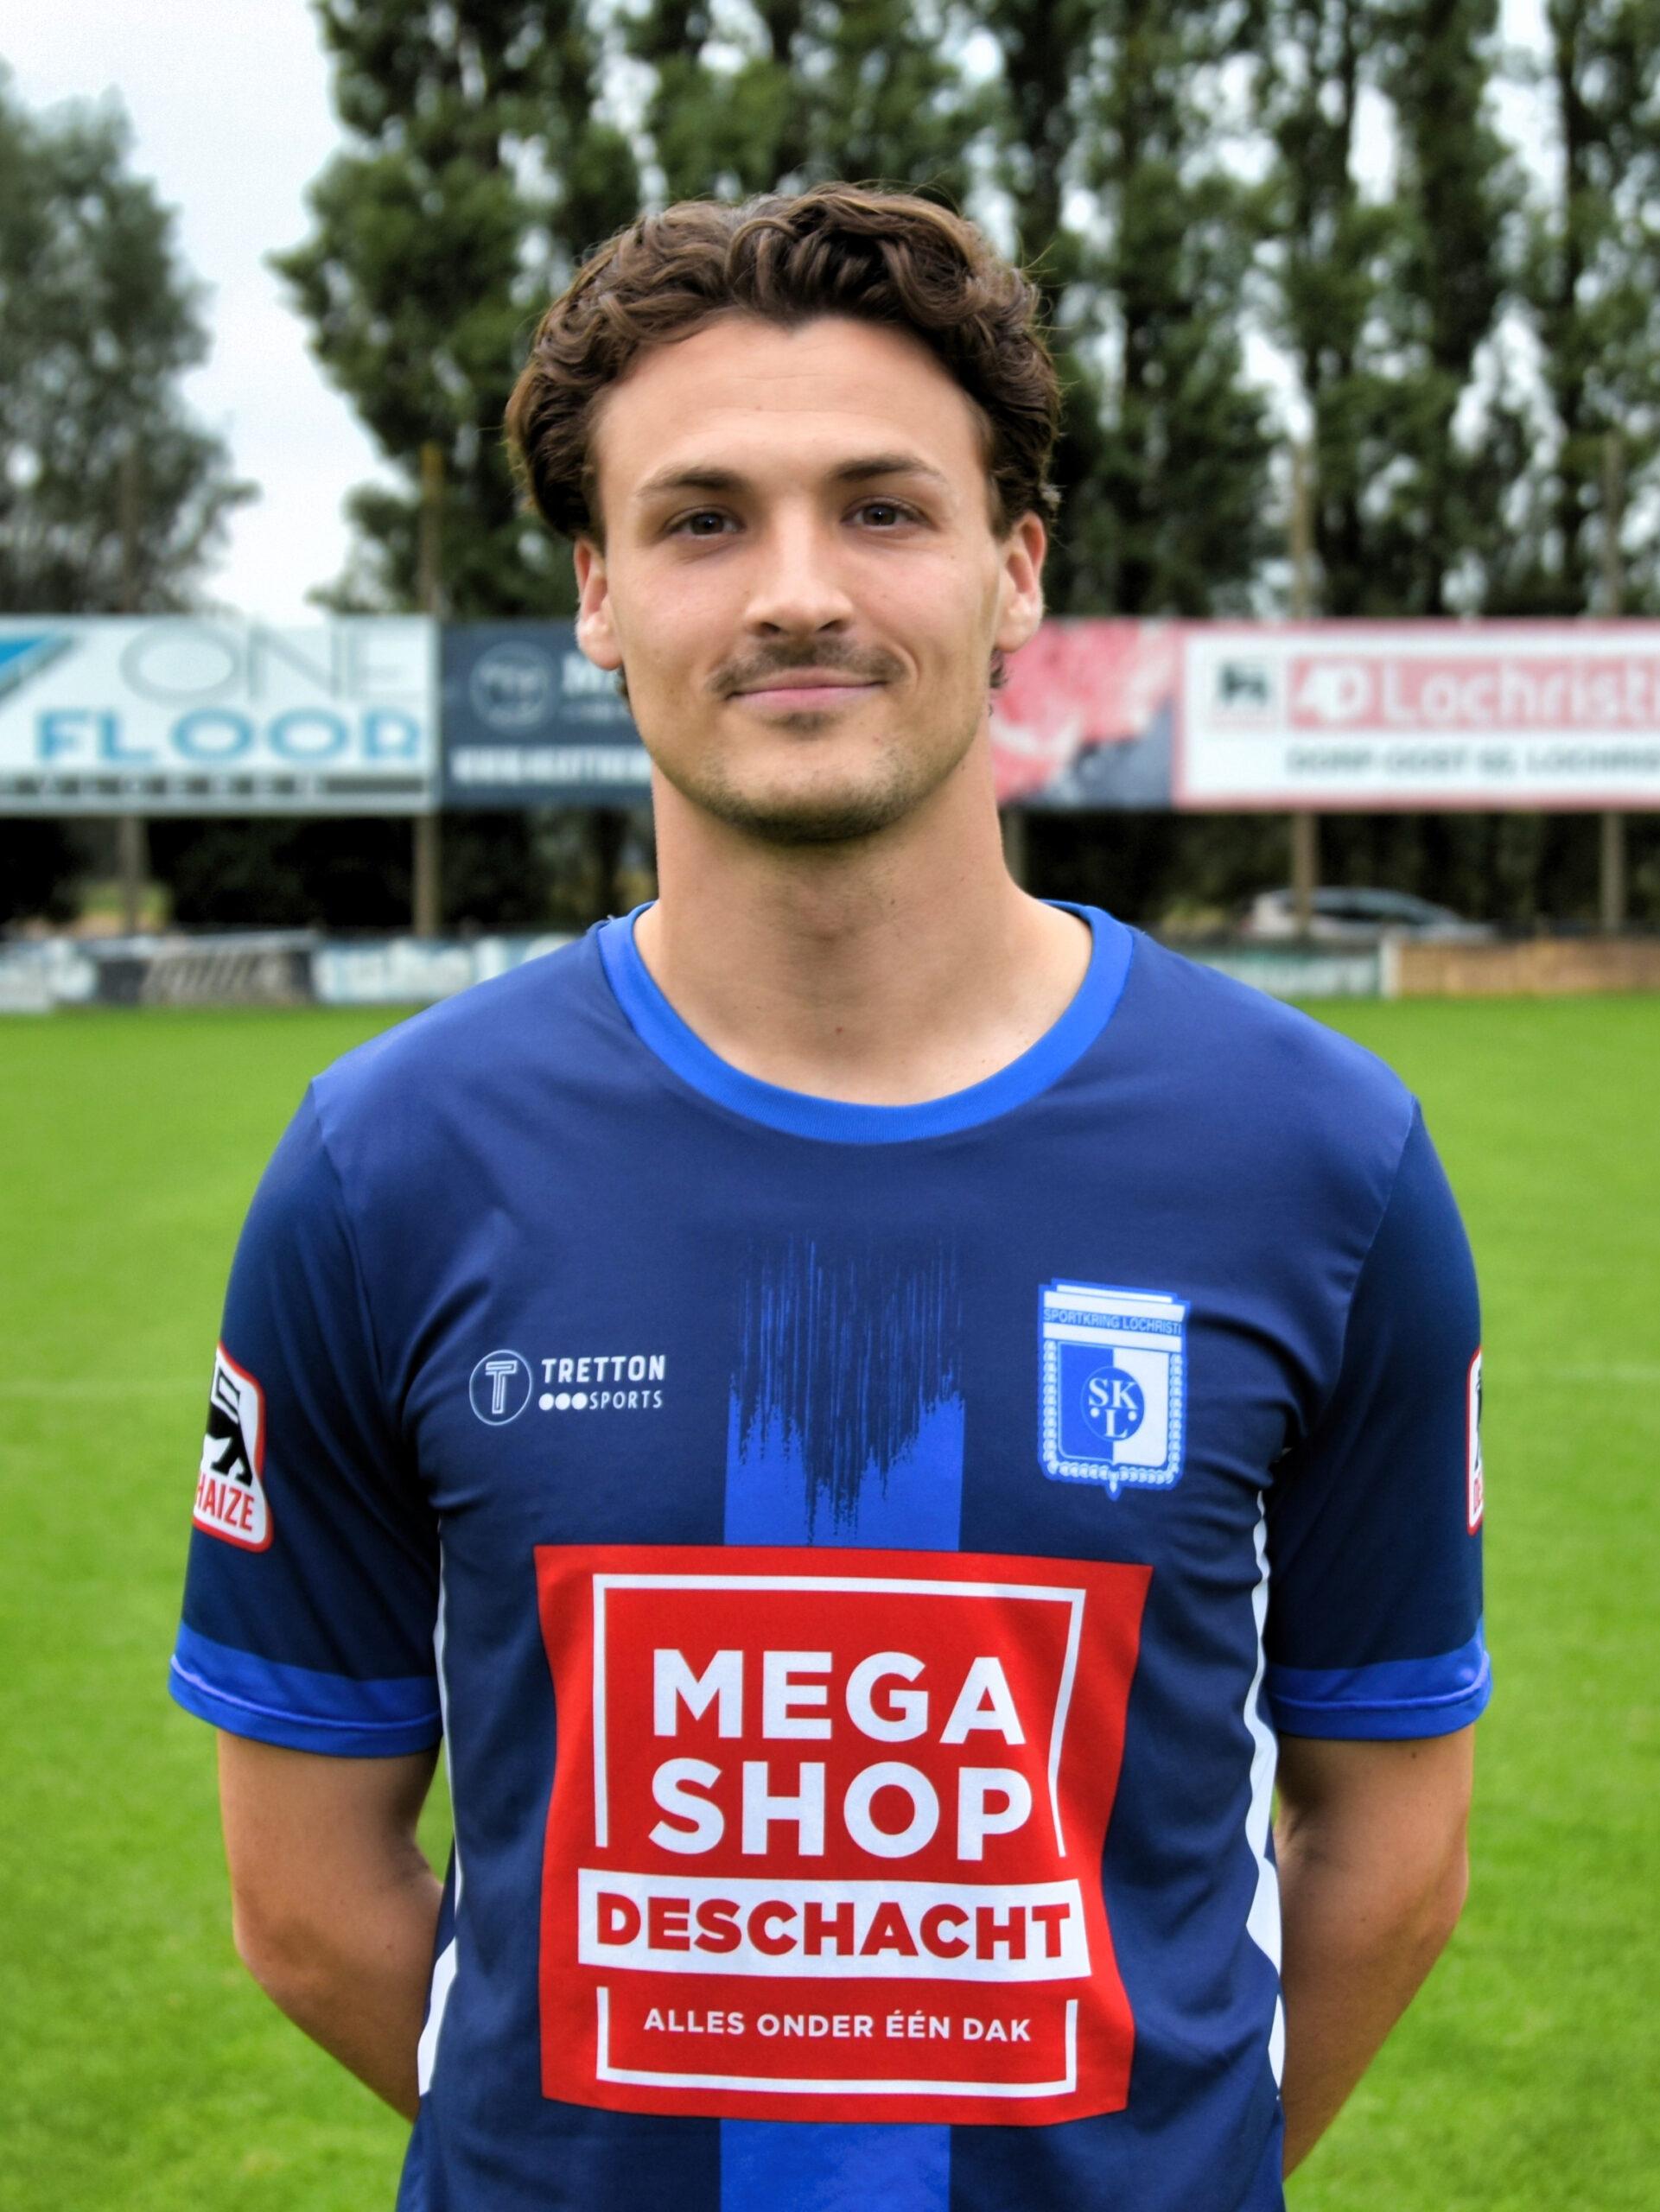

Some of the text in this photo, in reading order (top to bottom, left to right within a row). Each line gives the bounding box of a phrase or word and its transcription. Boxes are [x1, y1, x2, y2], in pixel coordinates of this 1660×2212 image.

[119, 622, 425, 704] ONE
[37, 709, 421, 761] FLOOR
[1043, 1308, 1182, 1335] SPORTKRING LOCHRISTI
[541, 1354, 666, 1383] TRETTON
[588, 1389, 663, 1410] SPORTS
[653, 1648, 1027, 1745] MEGA
[648, 1758, 1034, 1861] SHOP
[596, 1891, 1071, 1961] DESCHACHT
[644, 2008, 1032, 2043] ALLES ONDER ÉÉN DAK
